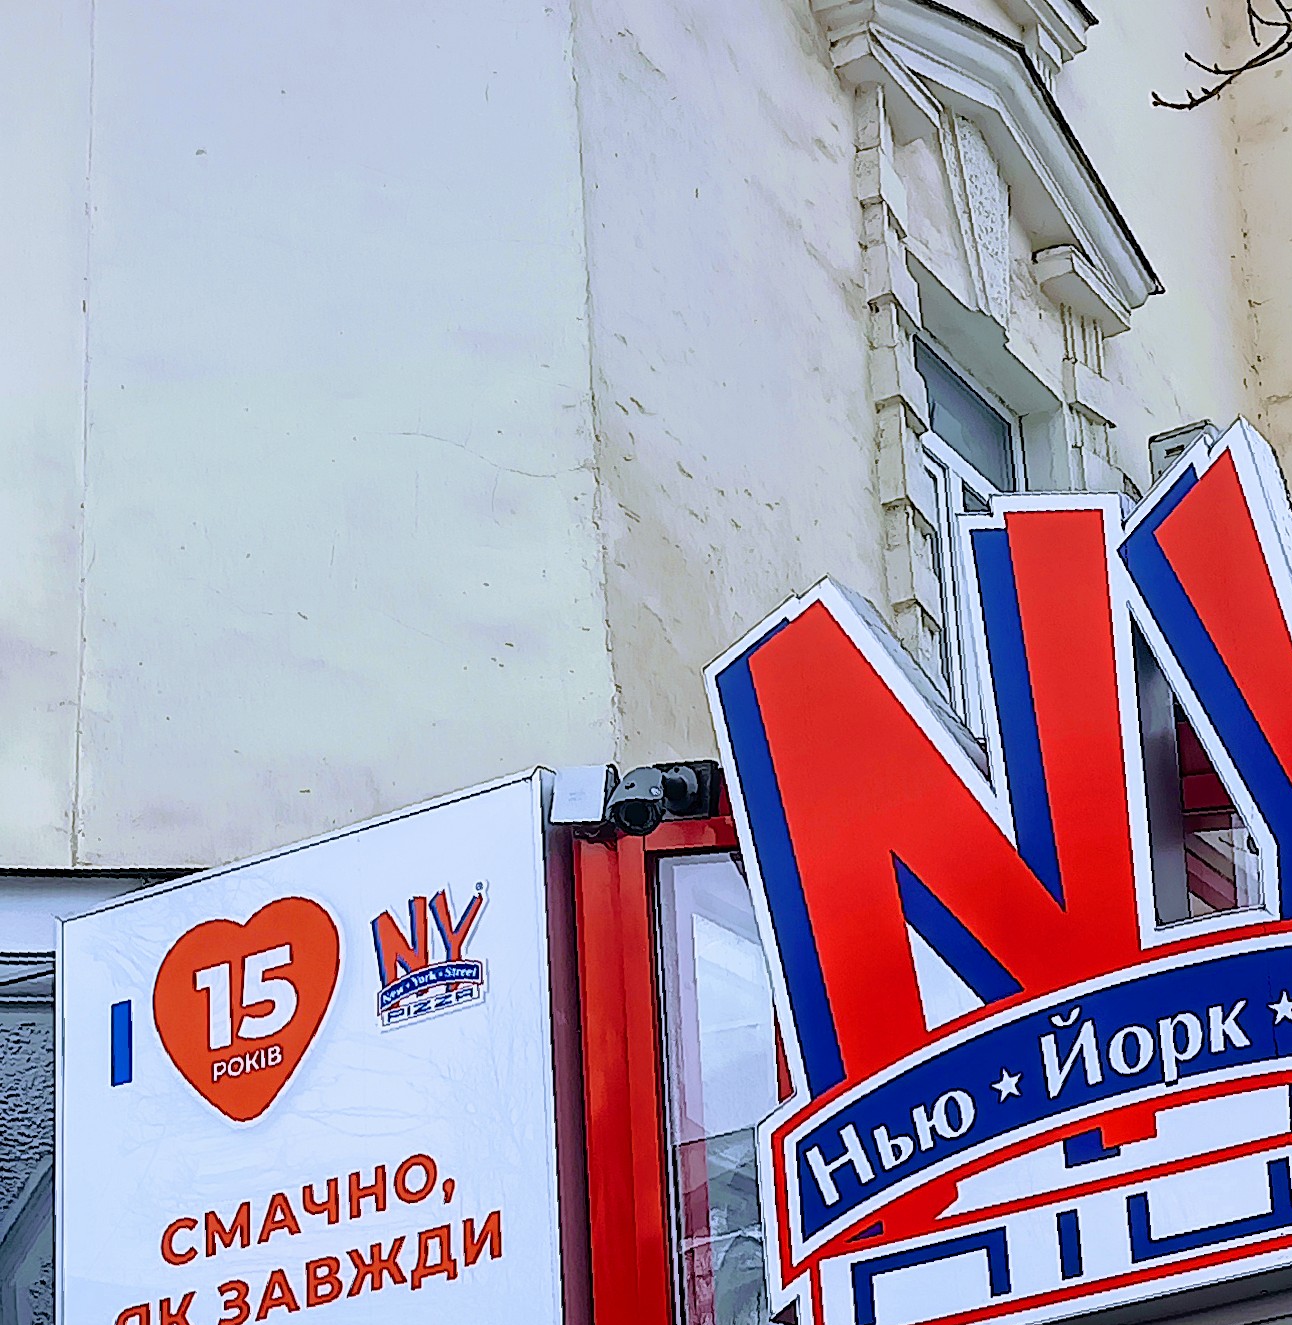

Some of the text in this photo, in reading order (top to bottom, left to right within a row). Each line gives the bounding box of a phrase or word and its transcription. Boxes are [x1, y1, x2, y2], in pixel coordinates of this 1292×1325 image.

[194, 943, 299, 1052] 15
[387, 987, 474, 1023] PIZZA
[211, 1045, 283, 1083] РОКІВ
[806, 1084, 977, 1207] Нью
[1039, 1003, 1250, 1101] Йорк
[160, 1152, 457, 1266] СМАЧНО,
